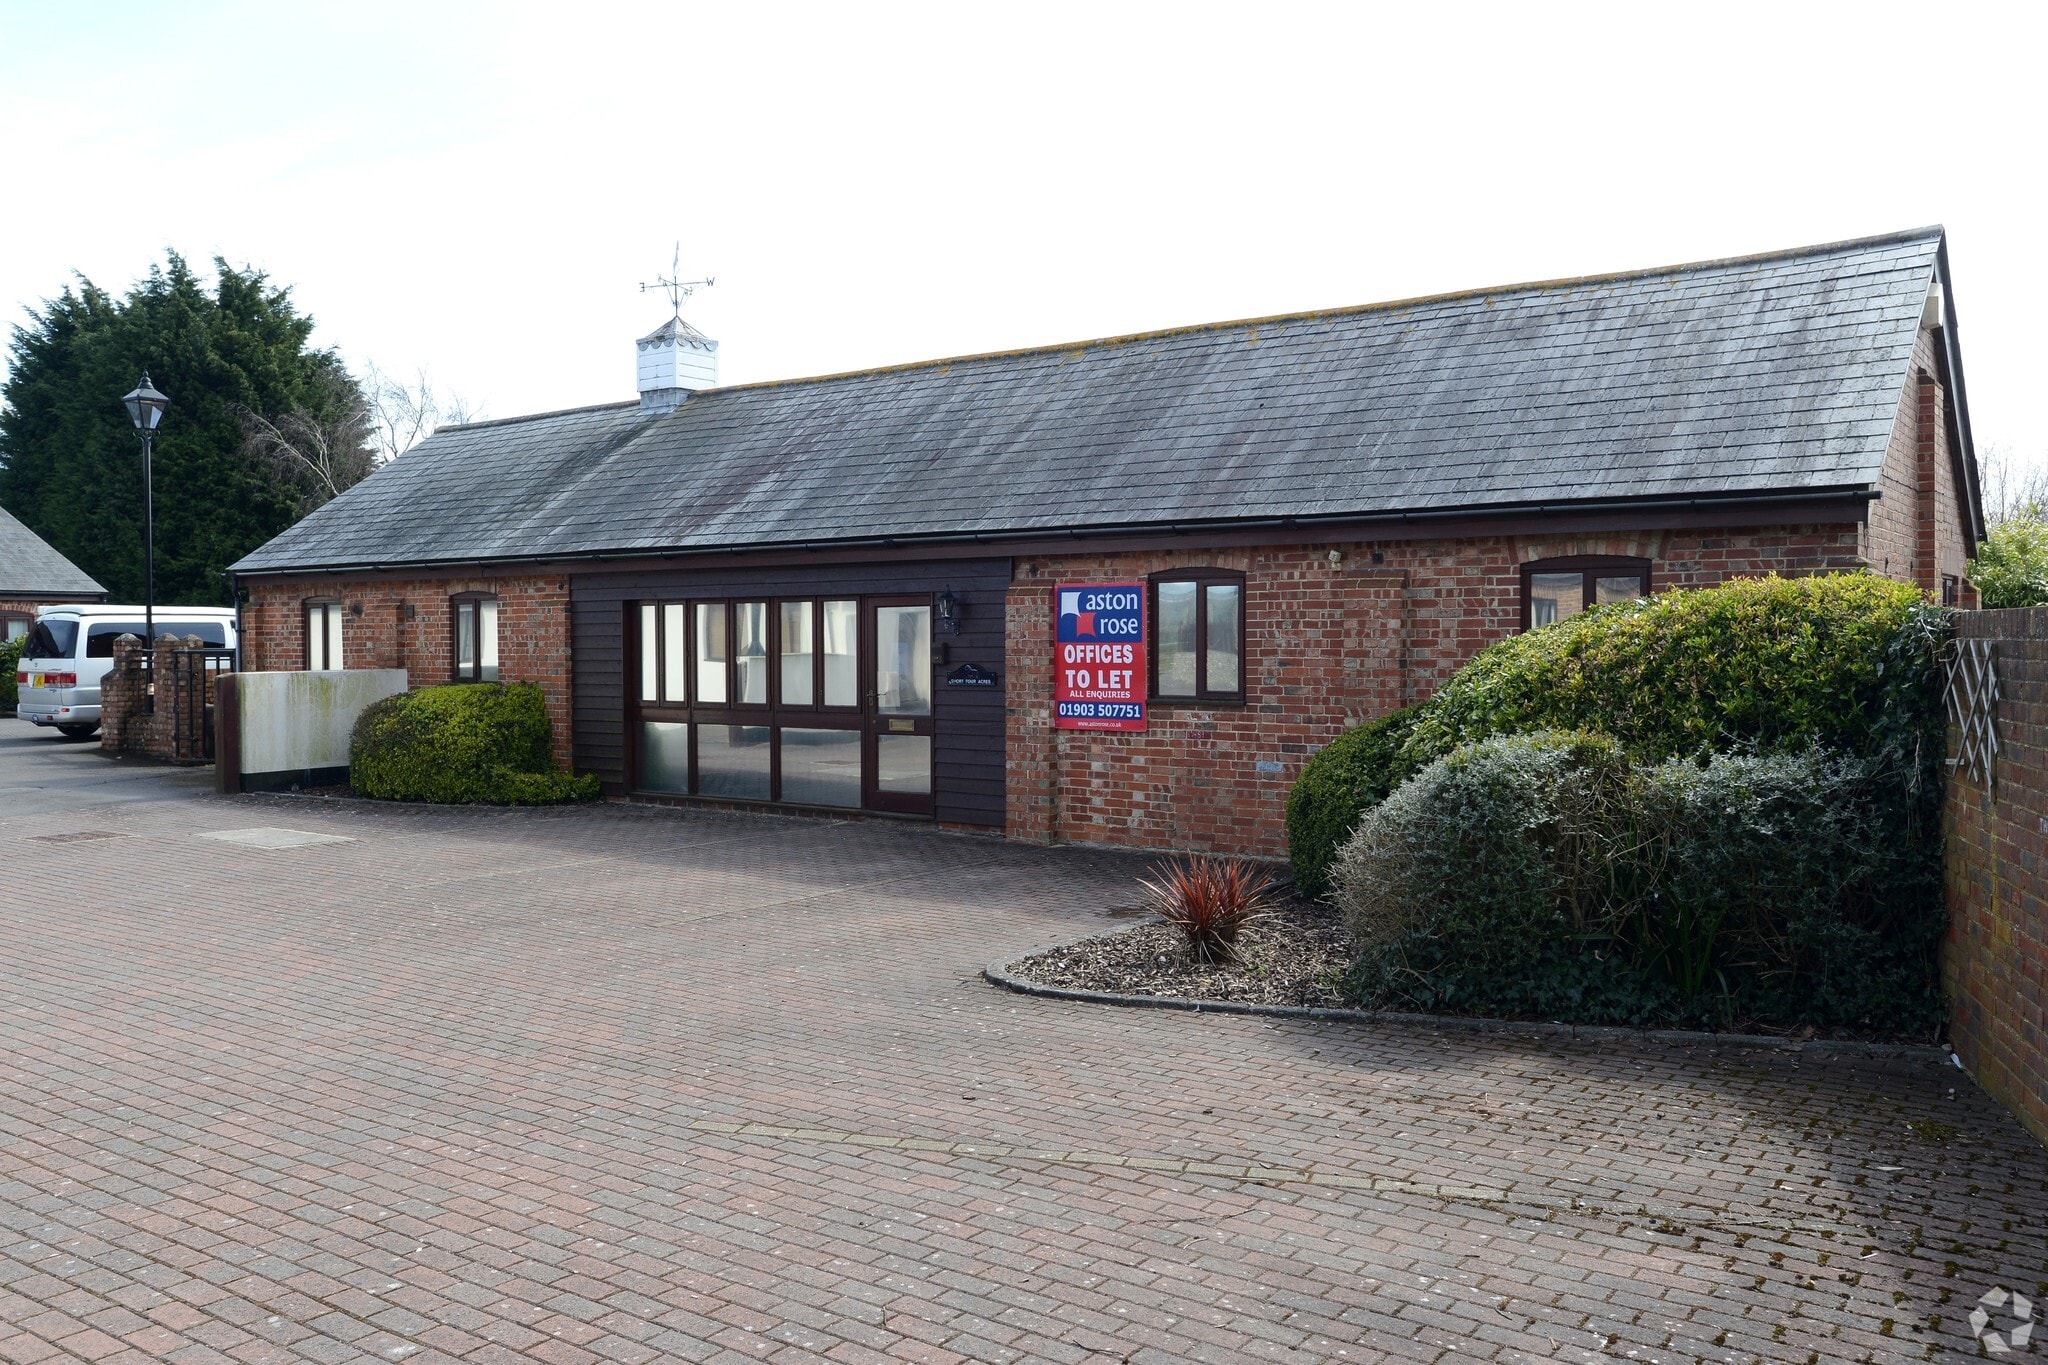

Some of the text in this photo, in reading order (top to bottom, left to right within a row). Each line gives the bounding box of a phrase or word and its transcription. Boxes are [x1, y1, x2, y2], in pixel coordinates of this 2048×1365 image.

[1086, 592, 1138, 610] aston
[1100, 618, 1138, 634] rose
[1064, 644, 1134, 664] OFFICES
[1066, 670, 1132, 689] TO LET
[1086, 690, 1131, 699] ENQUIRIES
[1059, 703, 1140, 718] 01903 507751
